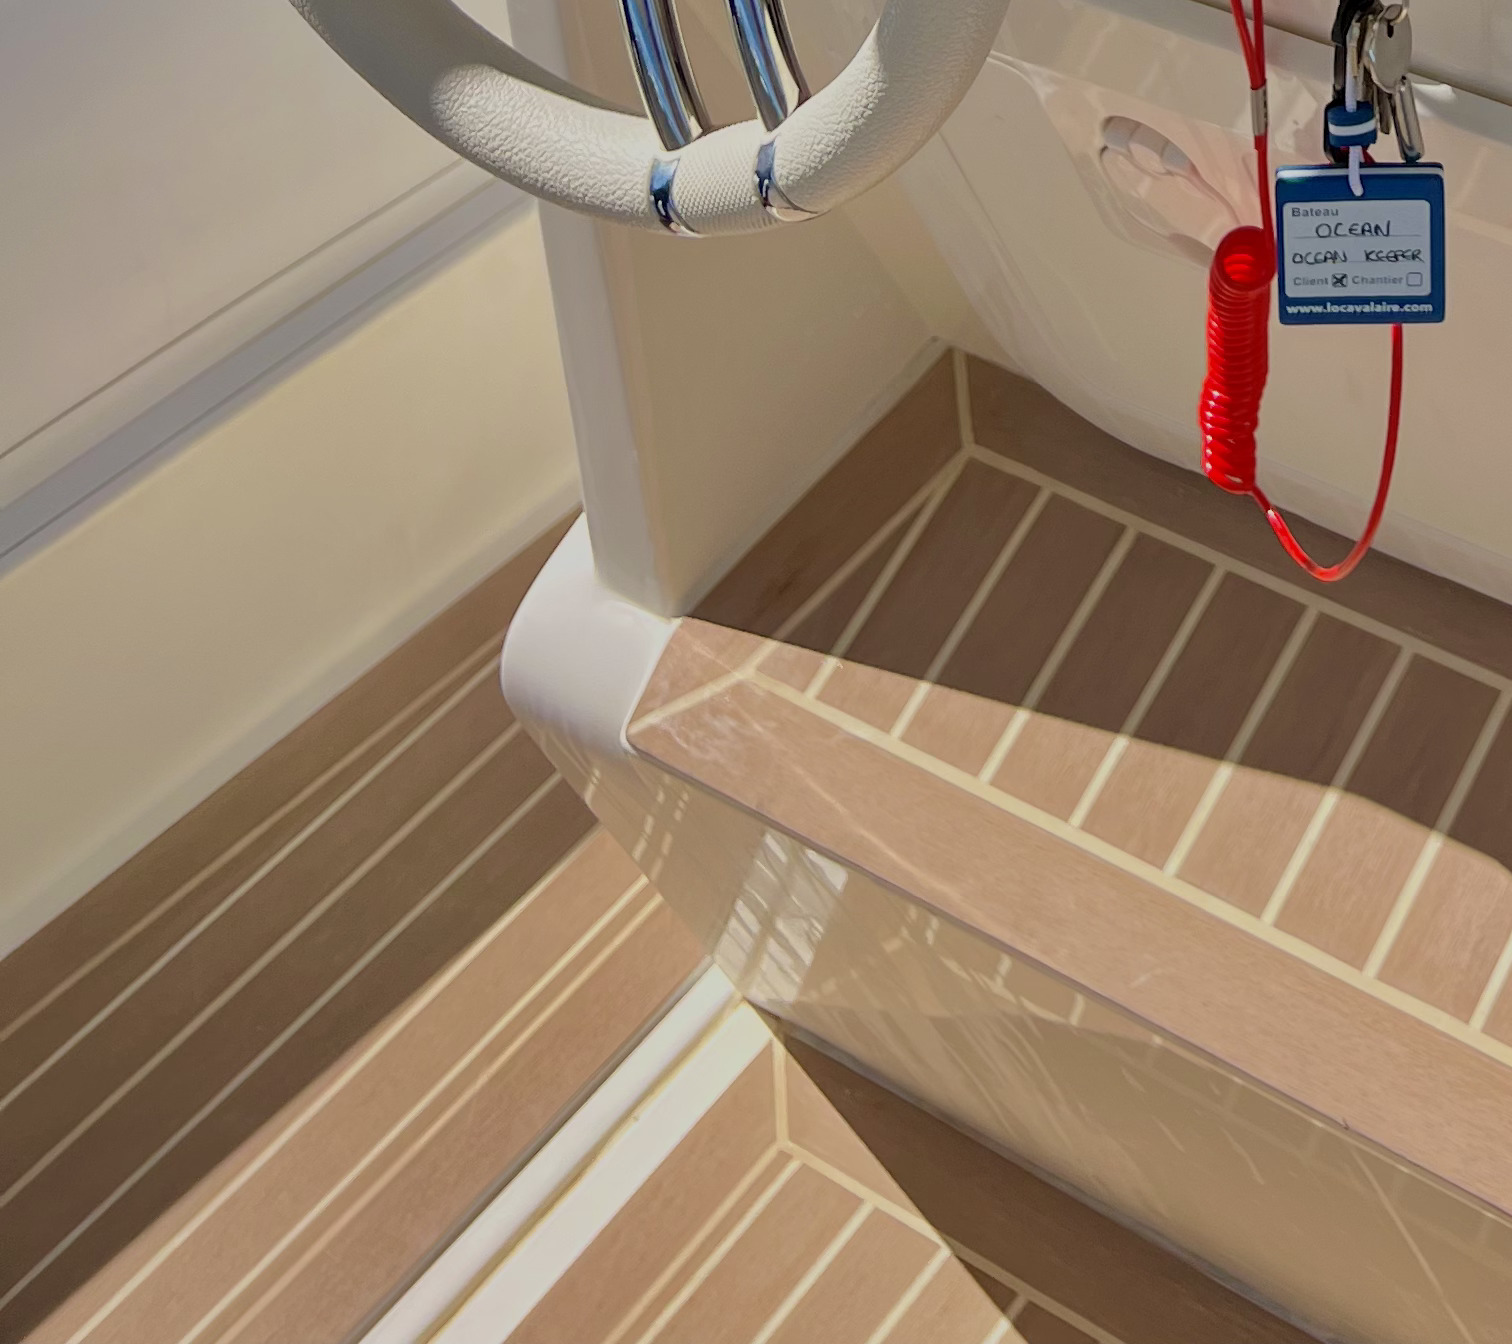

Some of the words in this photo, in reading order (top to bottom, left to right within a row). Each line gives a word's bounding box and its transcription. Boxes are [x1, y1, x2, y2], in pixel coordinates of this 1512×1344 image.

[1291, 207, 1339, 217] Bateau
[1315, 220, 1391, 238] OCEAN
[1292, 250, 1348, 265] OCEAN
[1293, 275, 1329, 287] Client
[1351, 273, 1404, 286] Chantier
[1286, 302, 1433, 314] www.locavalaire.com
